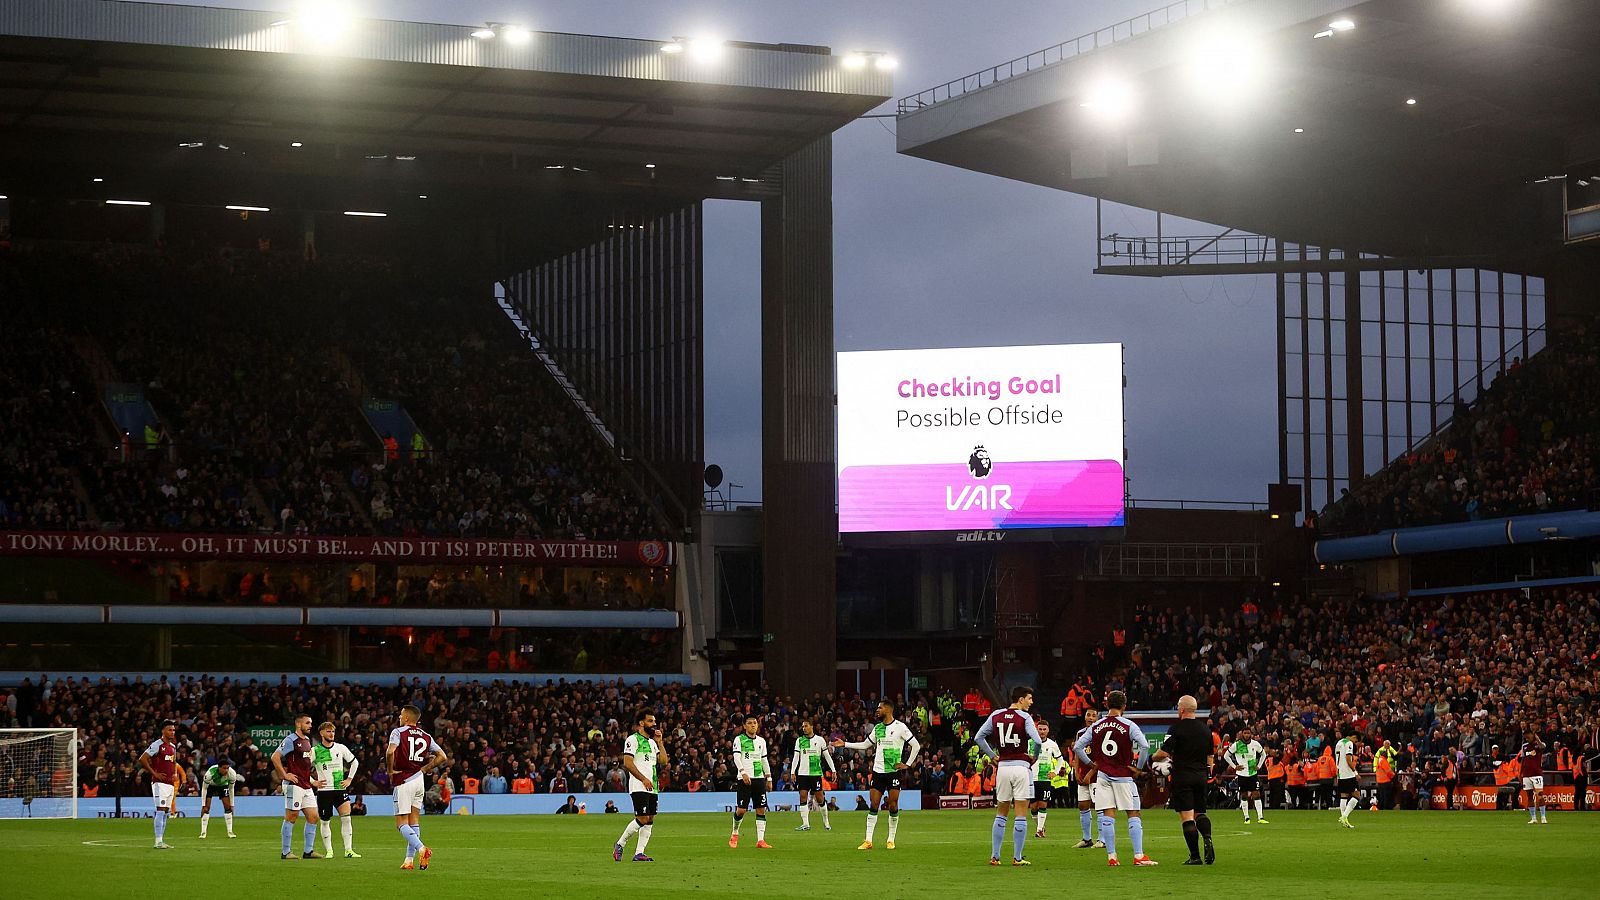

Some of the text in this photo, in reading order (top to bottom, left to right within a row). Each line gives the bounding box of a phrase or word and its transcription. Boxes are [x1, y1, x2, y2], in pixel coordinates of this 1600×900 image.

[897, 374, 1061, 400] Checking Goal
[897, 404, 1063, 428] Possible Offside
[946, 484, 1013, 511] VAR
[7, 534, 618, 559] TONY MORLEY... OH, IT MUST BE!... AND IT IS! PETER WITHE!!
[956, 531, 1006, 542] adi.tv
[251, 729, 292, 738] FIRST AID
[260, 738, 281, 747] POST
[996, 722, 1021, 748] 14
[1101, 730, 1118, 757] 6
[407, 736, 428, 762] 12
[1481, 792, 1498, 803] Trad
